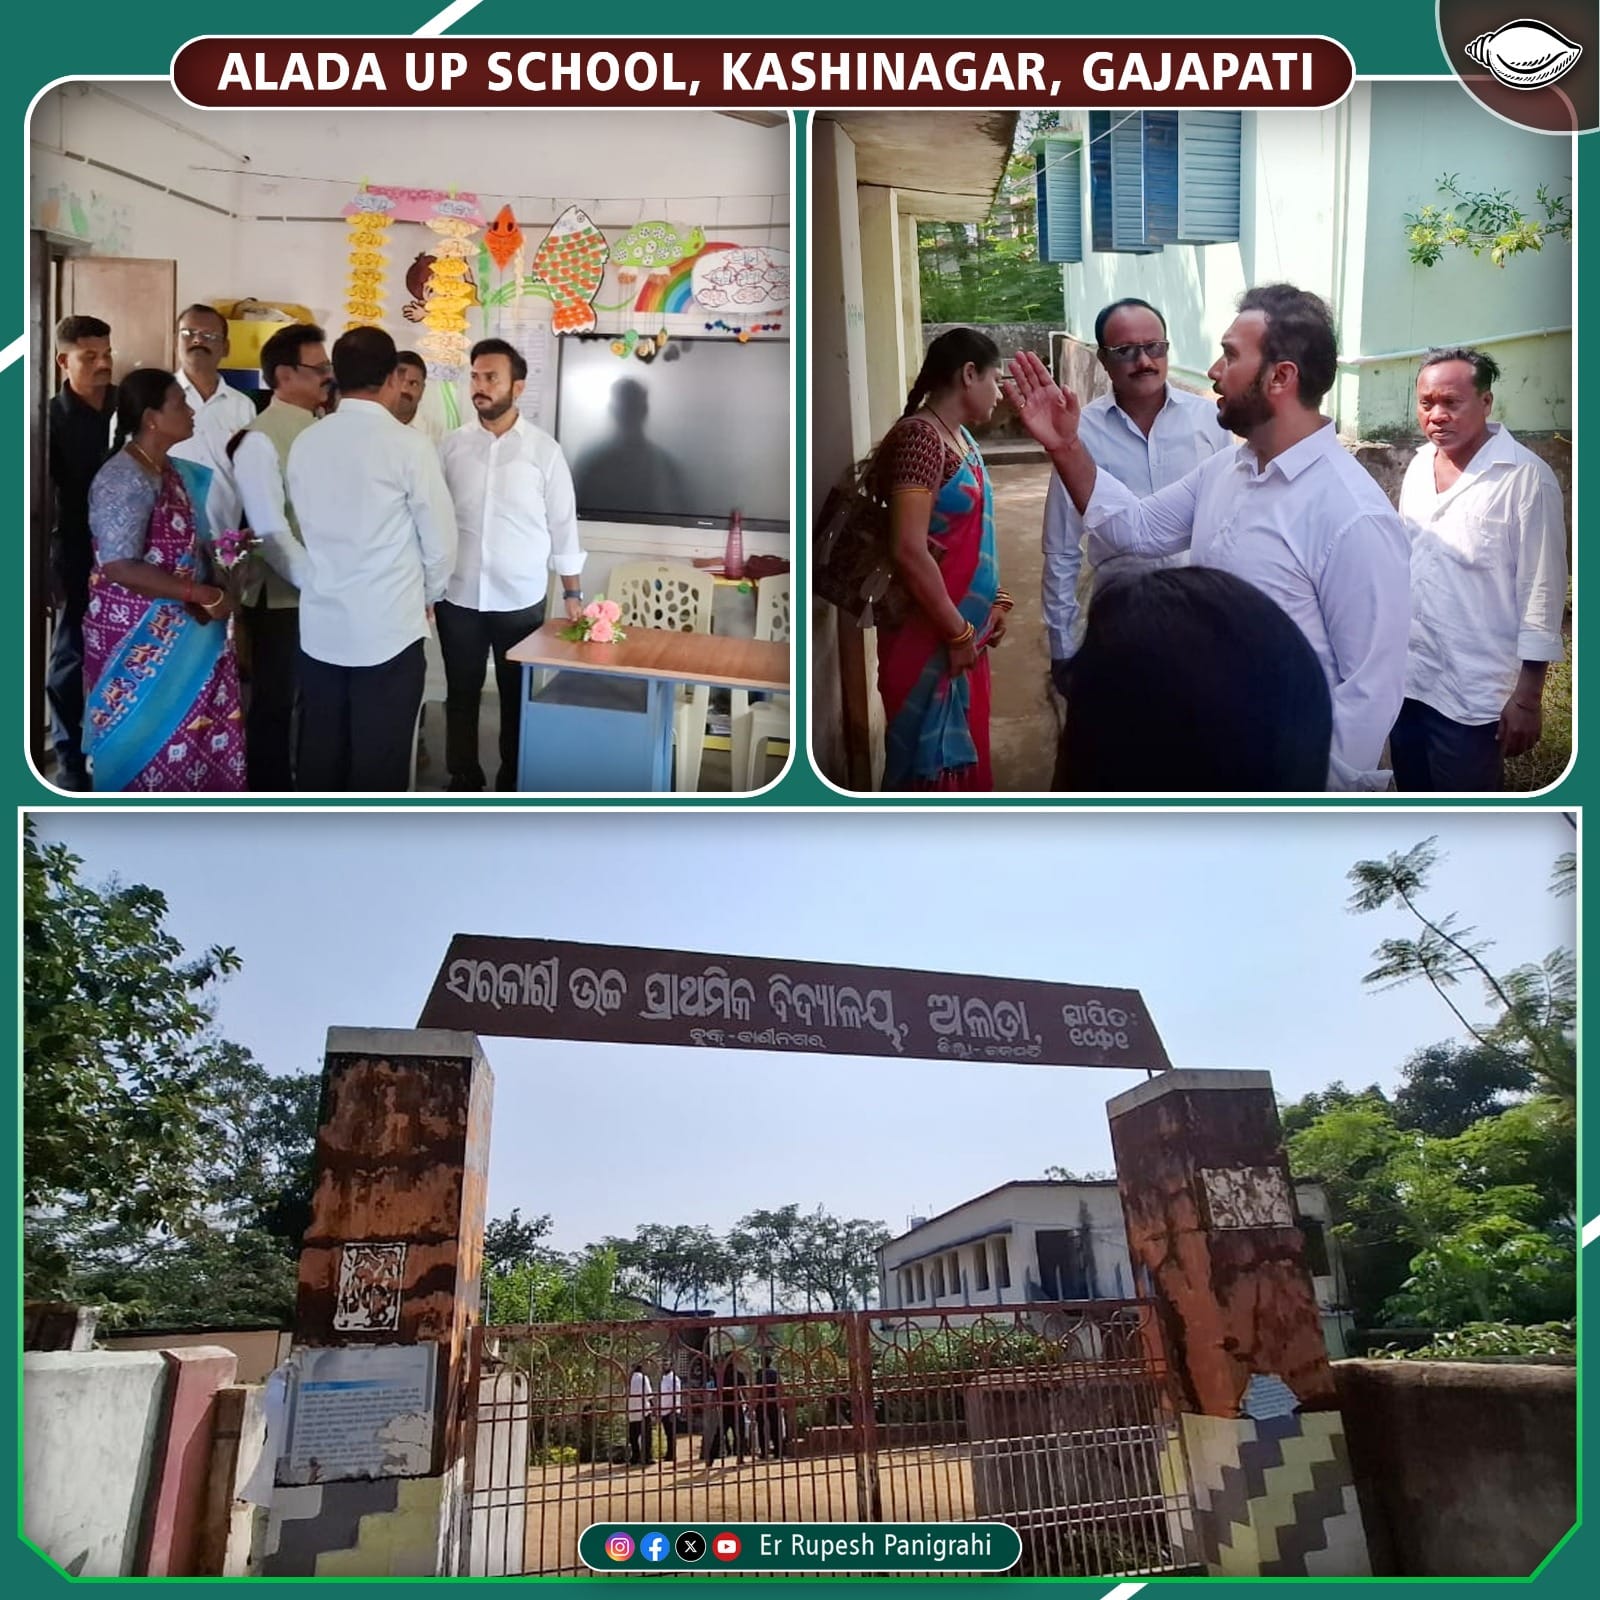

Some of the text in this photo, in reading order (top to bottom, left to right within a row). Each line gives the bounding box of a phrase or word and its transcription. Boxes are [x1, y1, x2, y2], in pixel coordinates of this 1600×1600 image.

[446, 956, 559, 1013] ସରକାରୀ
[568, 967, 627, 1016] ଉଚ୍ଚ
[638, 966, 756, 1021] ପ୍ରାଥମିକ
